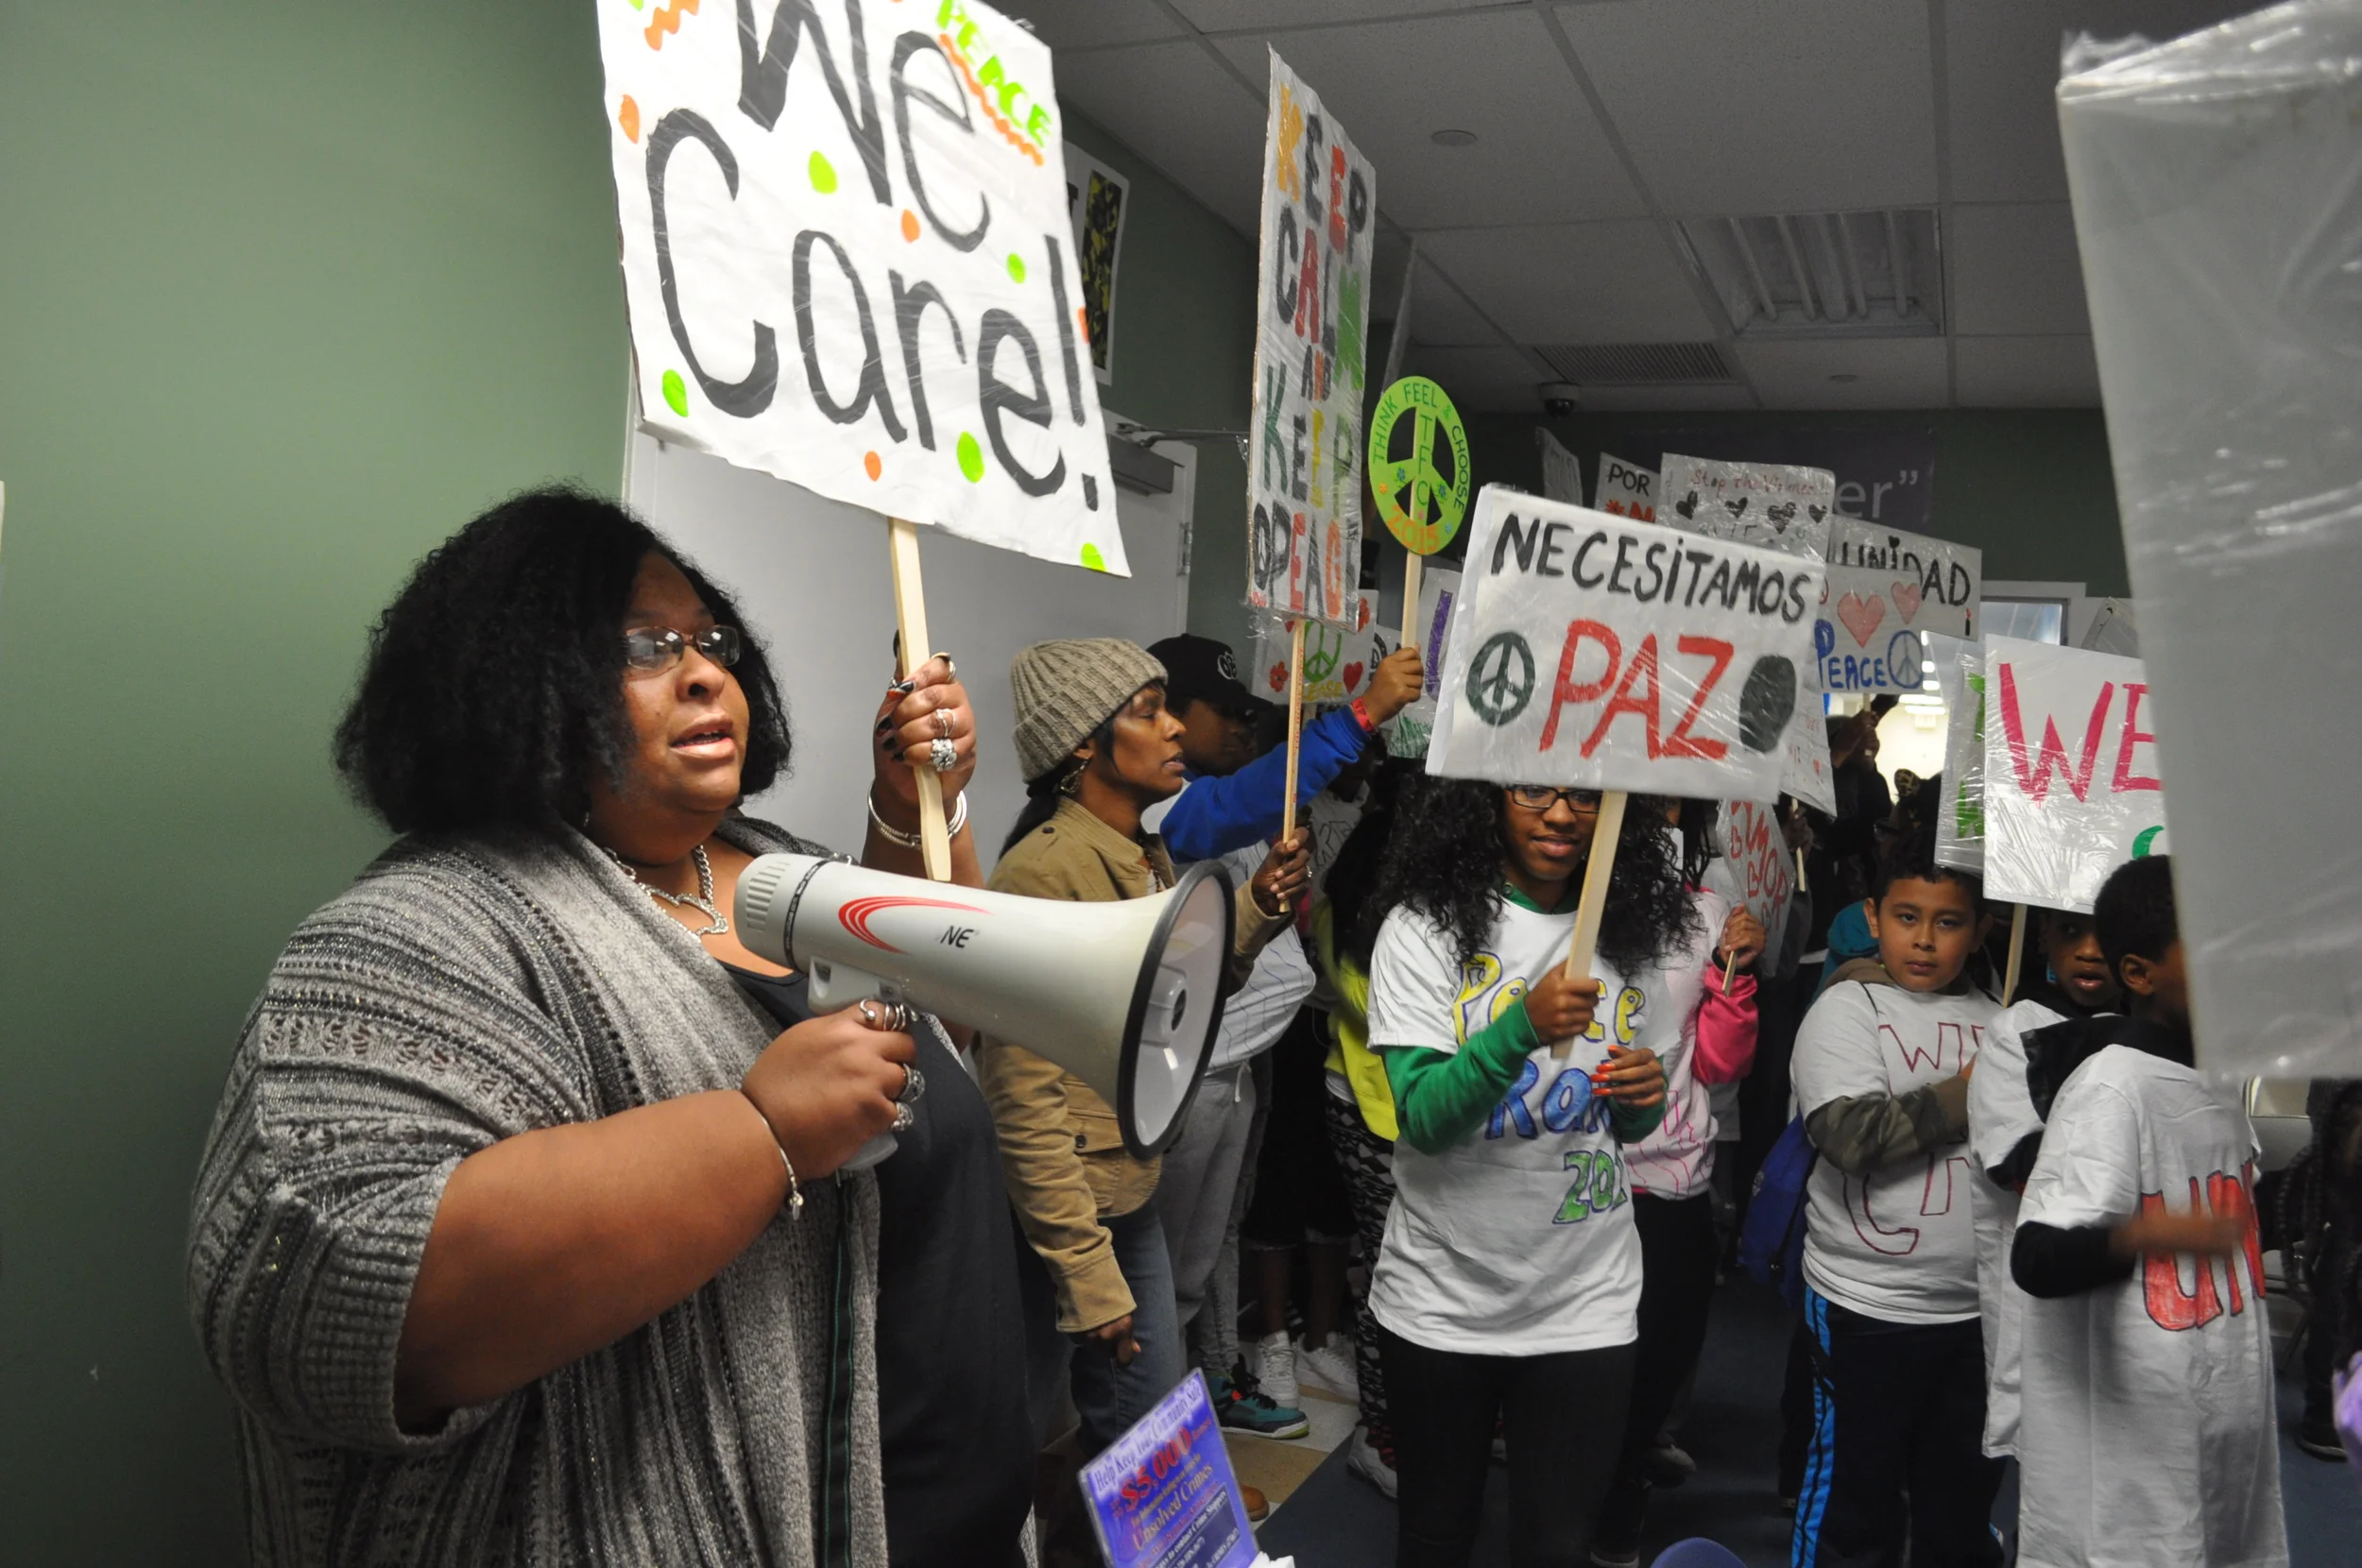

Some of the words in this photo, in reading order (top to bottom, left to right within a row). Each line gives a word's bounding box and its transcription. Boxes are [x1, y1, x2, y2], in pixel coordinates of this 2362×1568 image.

[738, 0, 990, 253] We
[1276, 82, 1368, 265] KEEP
[645, 107, 1099, 512] Care!
[1276, 203, 1362, 391] CALM
[1373, 397, 1398, 465] THINK
[1403, 382, 1438, 408] FEEL
[1451, 425, 1470, 515] CHOOSE
[1607, 462, 1651, 497] POR
[1386, 503, 1442, 555] 2015
[1539, 619, 1736, 762] PAZ
[1814, 619, 1889, 691] PEACE
[1094, 1463, 1117, 1491] Help
[1133, 1491, 1182, 1552] Unsolved
[1180, 1466, 1213, 1501] Crimes
